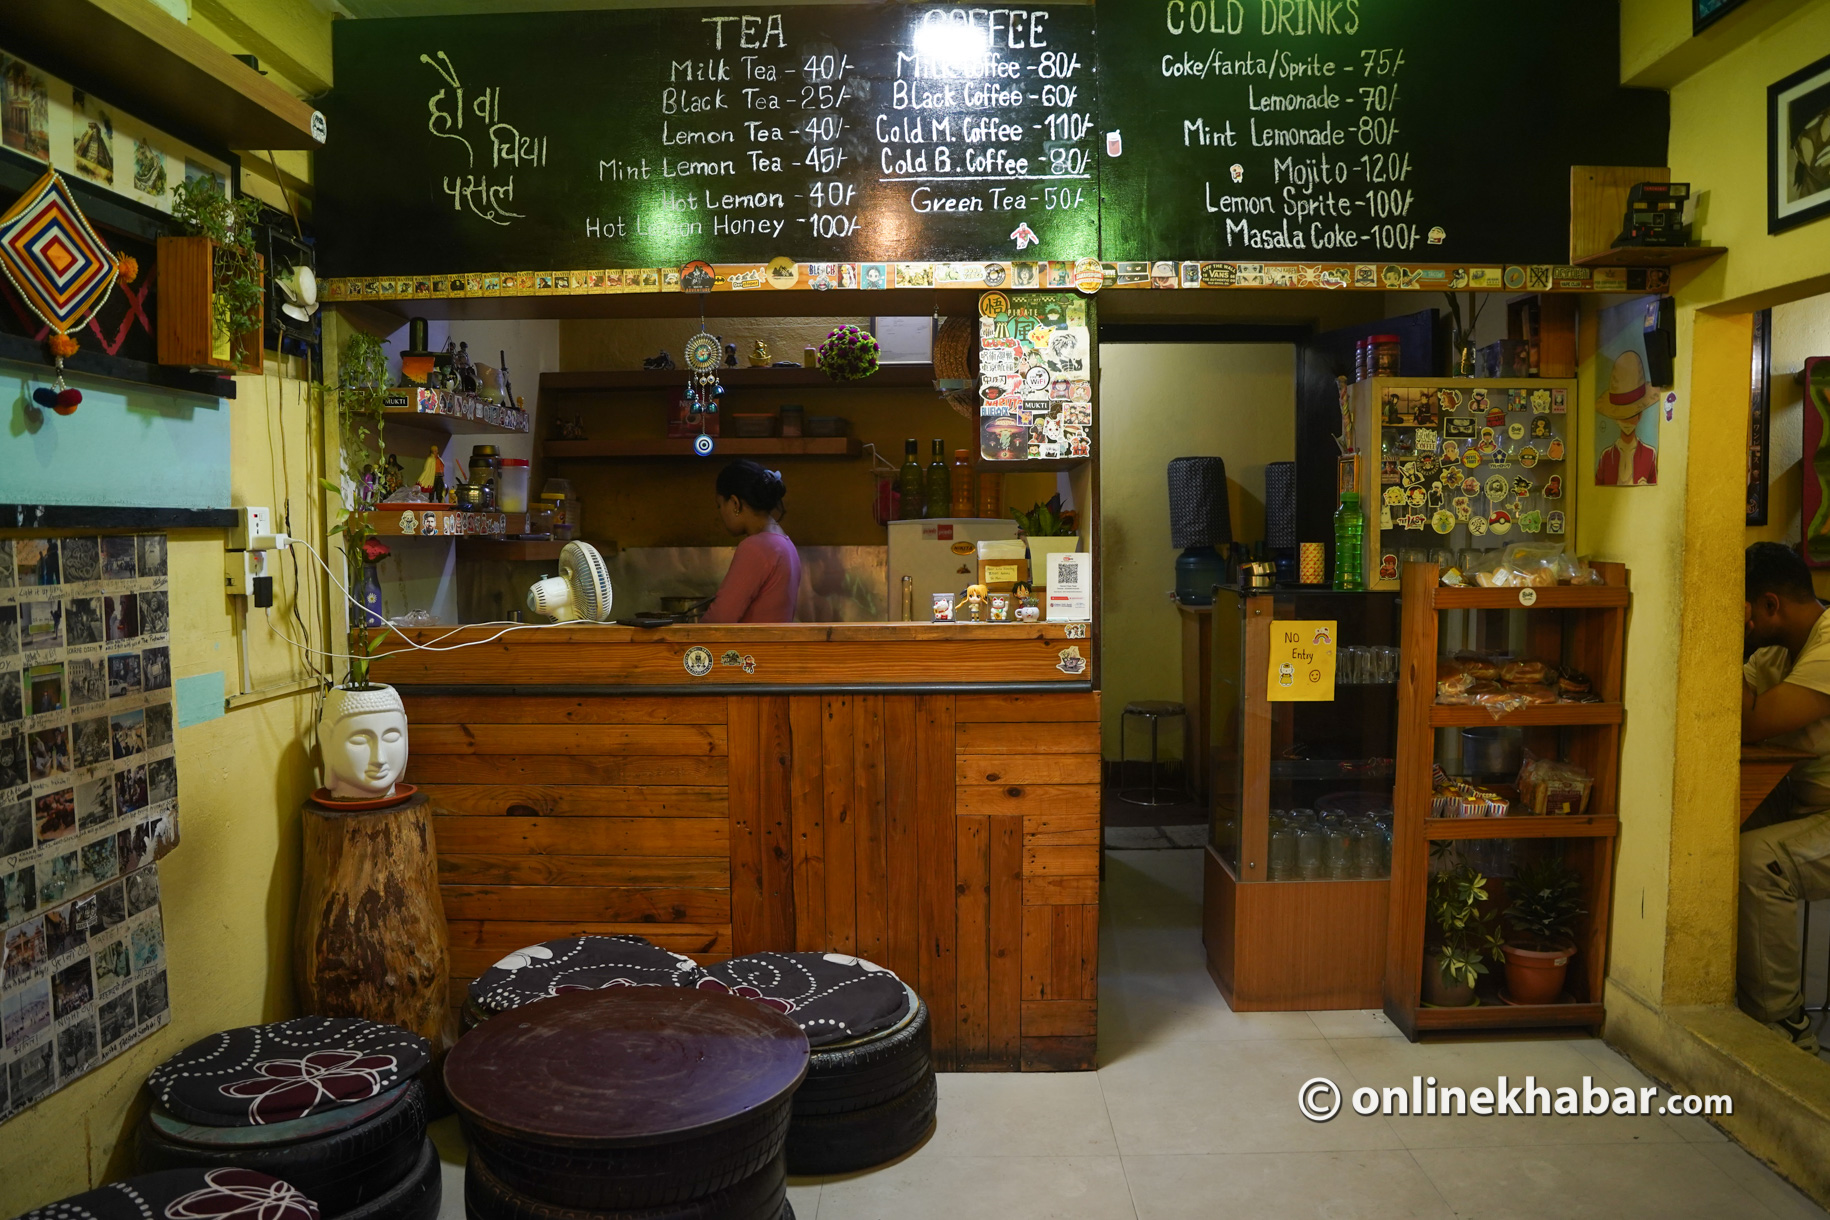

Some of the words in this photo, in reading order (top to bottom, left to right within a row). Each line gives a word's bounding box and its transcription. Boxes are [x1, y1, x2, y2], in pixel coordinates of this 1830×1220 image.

[702, 14, 787, 50] TEA
[1166, 0, 1244, 36] COLD
[1261, 0, 1360, 36] DRINKS
[671, 59, 730, 82] Milk
[741, 56, 776, 81] Tea
[662, 87, 728, 114] Black
[742, 88, 780, 109] Tea
[893, 80, 957, 110] Black
[964, 82, 1023, 108] Coffee
[1249, 84, 1340, 111] Lemonade
[662, 120, 735, 146] Lemon
[744, 121, 784, 142] Tea
[876, 114, 924, 144] Cold
[932, 117, 956, 143] M.
[963, 117, 1024, 142] Coffee
[1184, 118, 1237, 147] Mint
[1250, 117, 1345, 147] Lemonade
[489, 123, 547, 169] चिया
[600, 158, 651, 181] Mint
[663, 157, 736, 179] Lemon
[747, 150, 783, 172] Tea
[881, 147, 927, 175] Cold
[965, 148, 1029, 174] Coffee
[1274, 152, 1347, 194] Mojito
[443, 175, 526, 226] पसल
[663, 189, 698, 212] Hot
[705, 188, 784, 209] Lemon
[910, 187, 984, 213] Green
[988, 187, 1026, 210] Tea
[1206, 181, 1276, 213] Lemon
[1283, 186, 1352, 224] Sprite
[586, 216, 626, 238] Hot
[714, 213, 784, 239] Honey
[1225, 218, 1306, 250] Masala
[1310, 221, 1358, 249] Coke
[809, 264, 836, 275] BLECH
[1209, 270, 1229, 278] VANS
[1292, 648, 1313, 664] Entry
